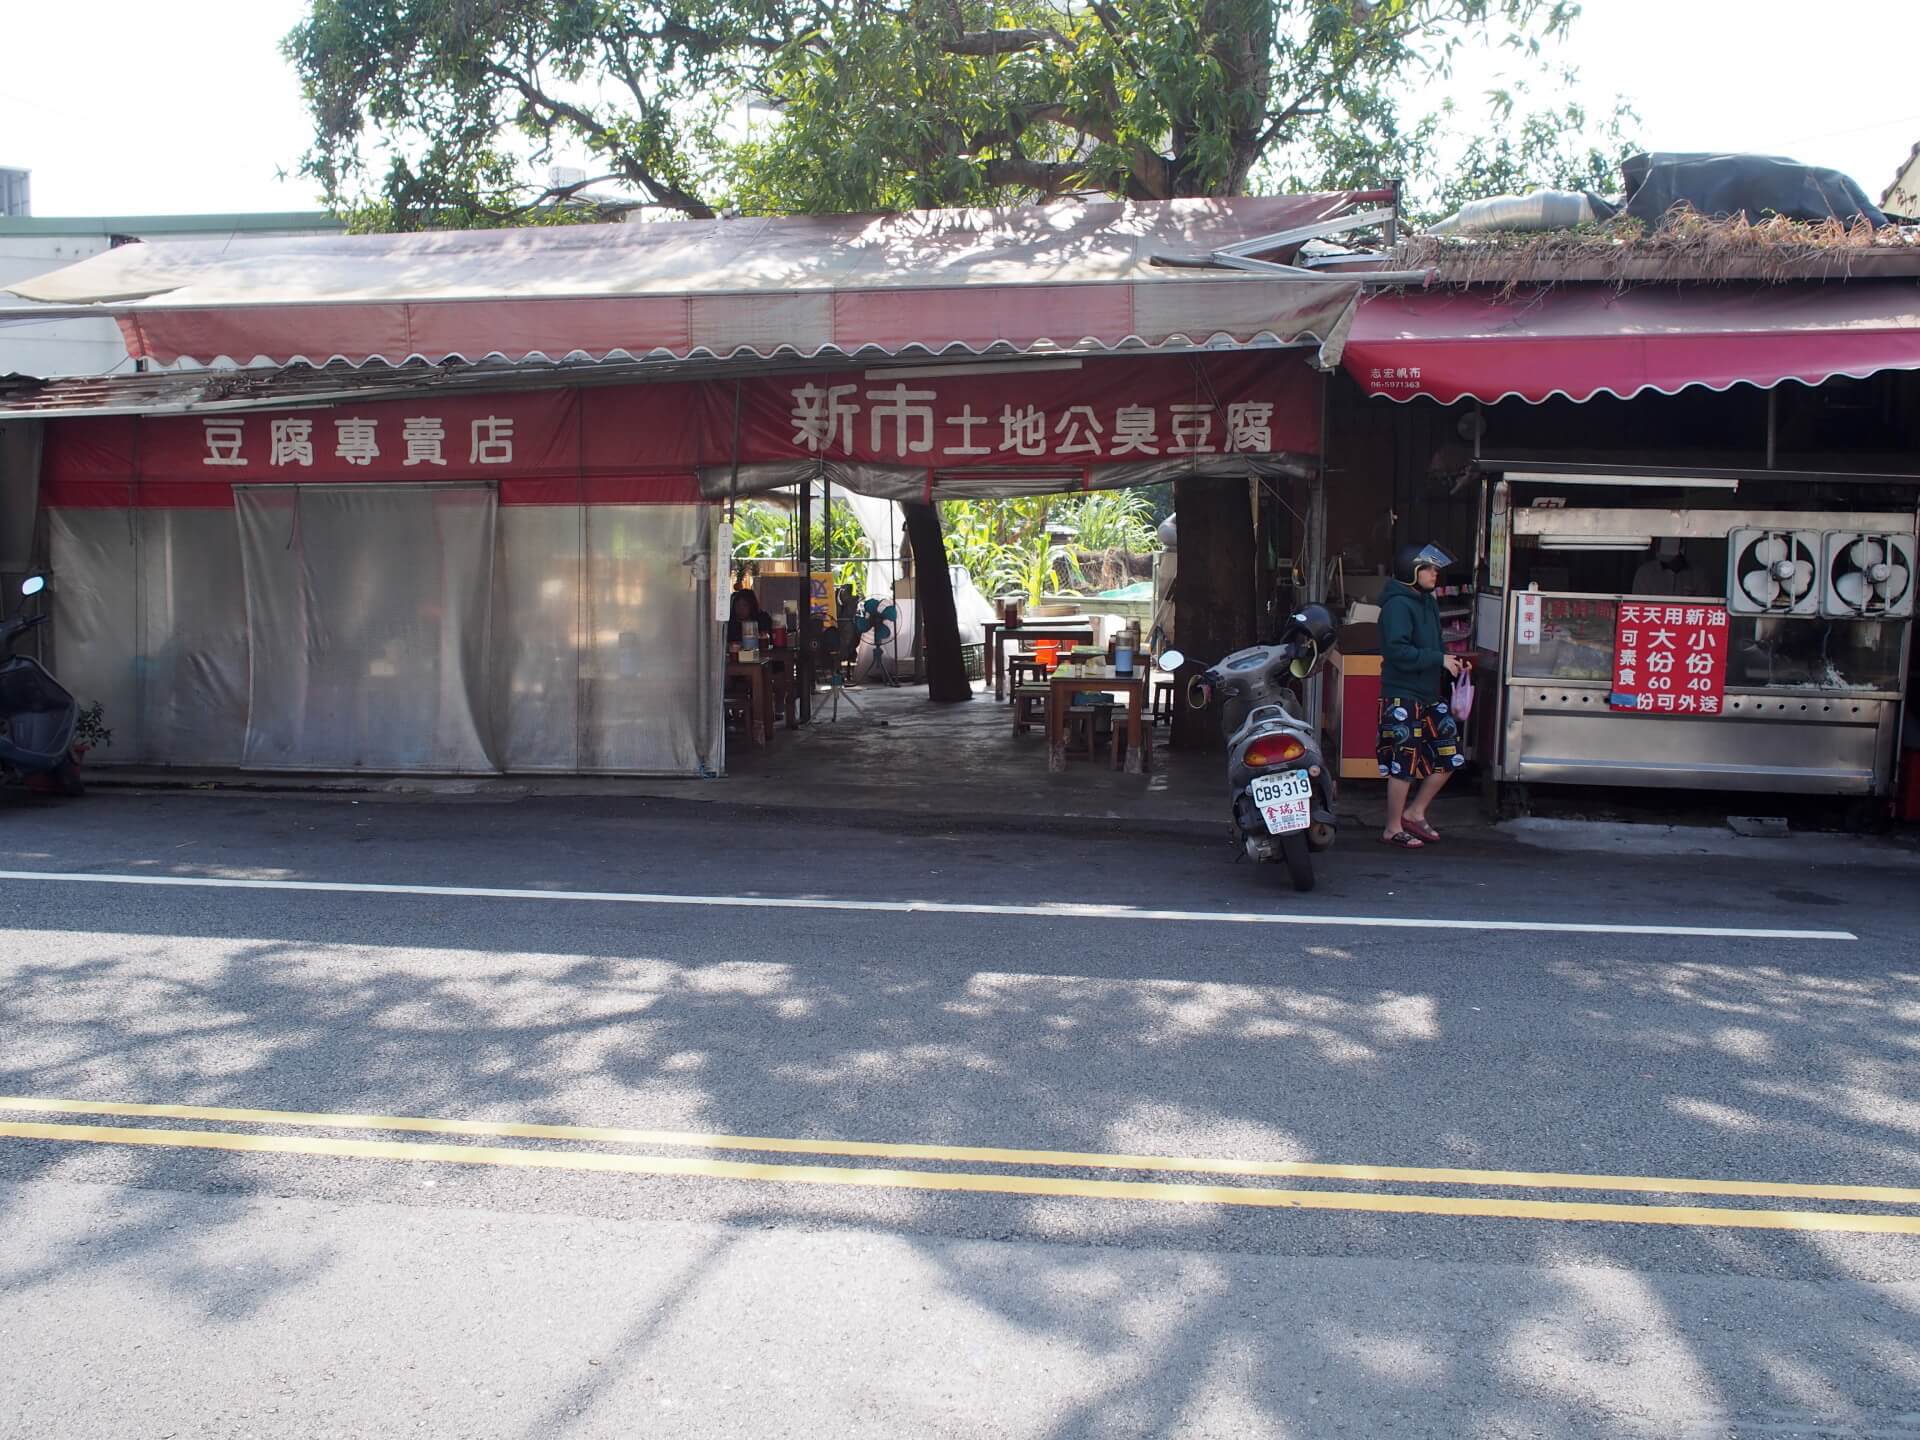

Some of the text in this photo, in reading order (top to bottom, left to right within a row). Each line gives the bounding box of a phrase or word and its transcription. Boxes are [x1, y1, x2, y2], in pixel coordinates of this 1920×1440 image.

[791, 382, 1274, 457] 新市土地公臭豆腐
[203, 415, 514, 466] 豆腐專賣店
[1621, 606, 1726, 626] 天天用新油
[1618, 629, 1638, 686] 可素食
[1647, 676, 1671, 690] 60
[1687, 677, 1712, 691] 40
[1255, 779, 1309, 802] CB9-319
